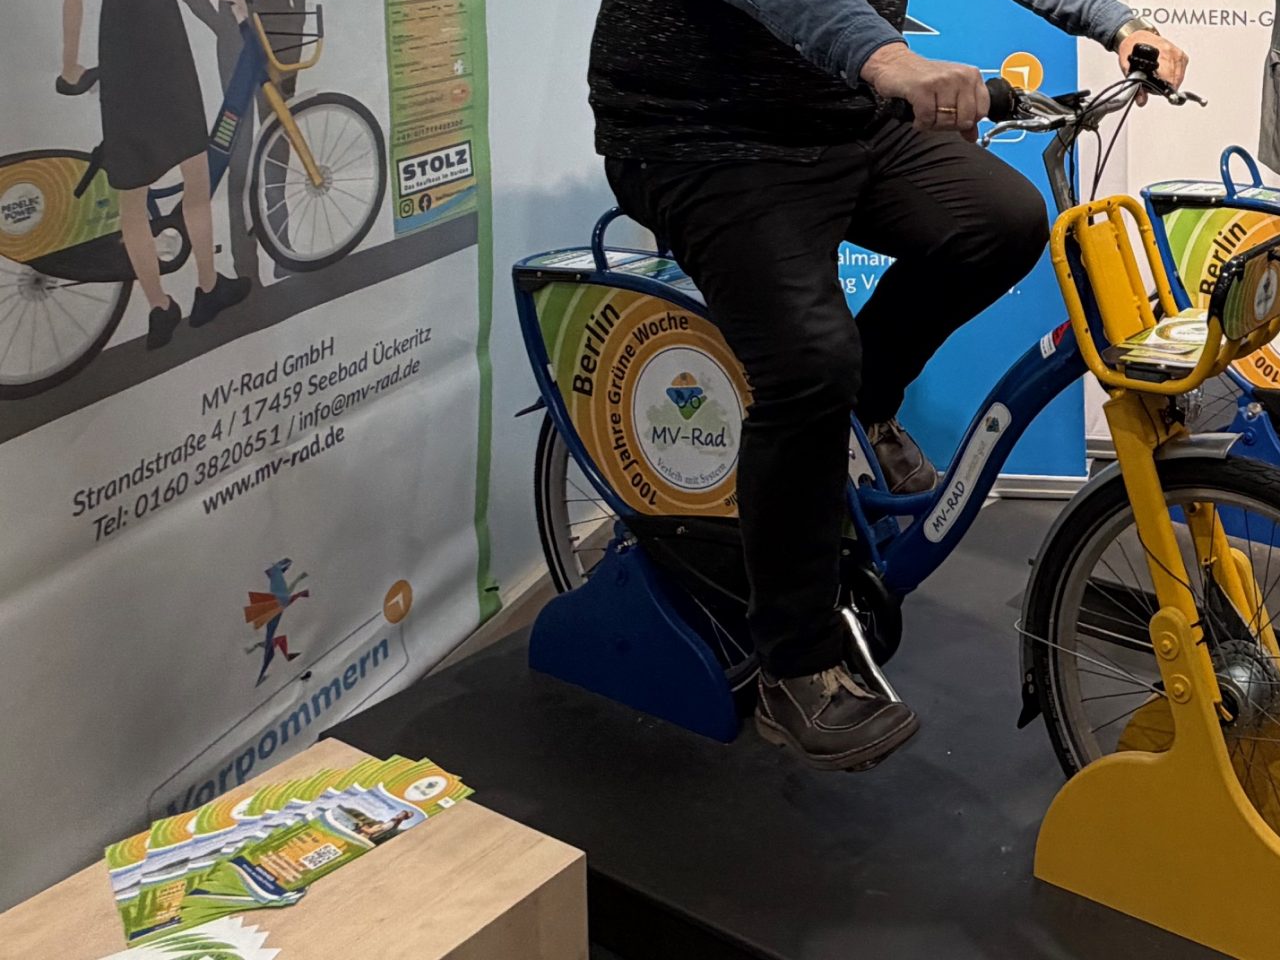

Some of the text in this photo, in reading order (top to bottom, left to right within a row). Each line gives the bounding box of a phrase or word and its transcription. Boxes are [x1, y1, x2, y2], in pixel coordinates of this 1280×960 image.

[402, 147, 469, 182] STOLZ
[404, 183, 416, 191] Das
[4, 205, 37, 221] POWER
[573, 303, 621, 397] Berlin
[632, 312, 690, 345] Woche
[201, 336, 335, 415] MV-Rad GmbH
[608, 345, 636, 405] Grüne
[1255, 355, 1280, 383] 100
[72, 326, 432, 517] Strandstraße 4 / 17459 Seebad Ückeritz
[612, 413, 640, 472] Jahre
[652, 427, 727, 448] MV-Rad
[93, 357, 421, 542] Tel: 0160 3820651 / info@mv-rad.de
[202, 424, 346, 515] www.mv-rad.de
[656, 457, 727, 485] Verleih mit System
[631, 474, 659, 506] 100
[932, 481, 966, 533] MV-RAD
